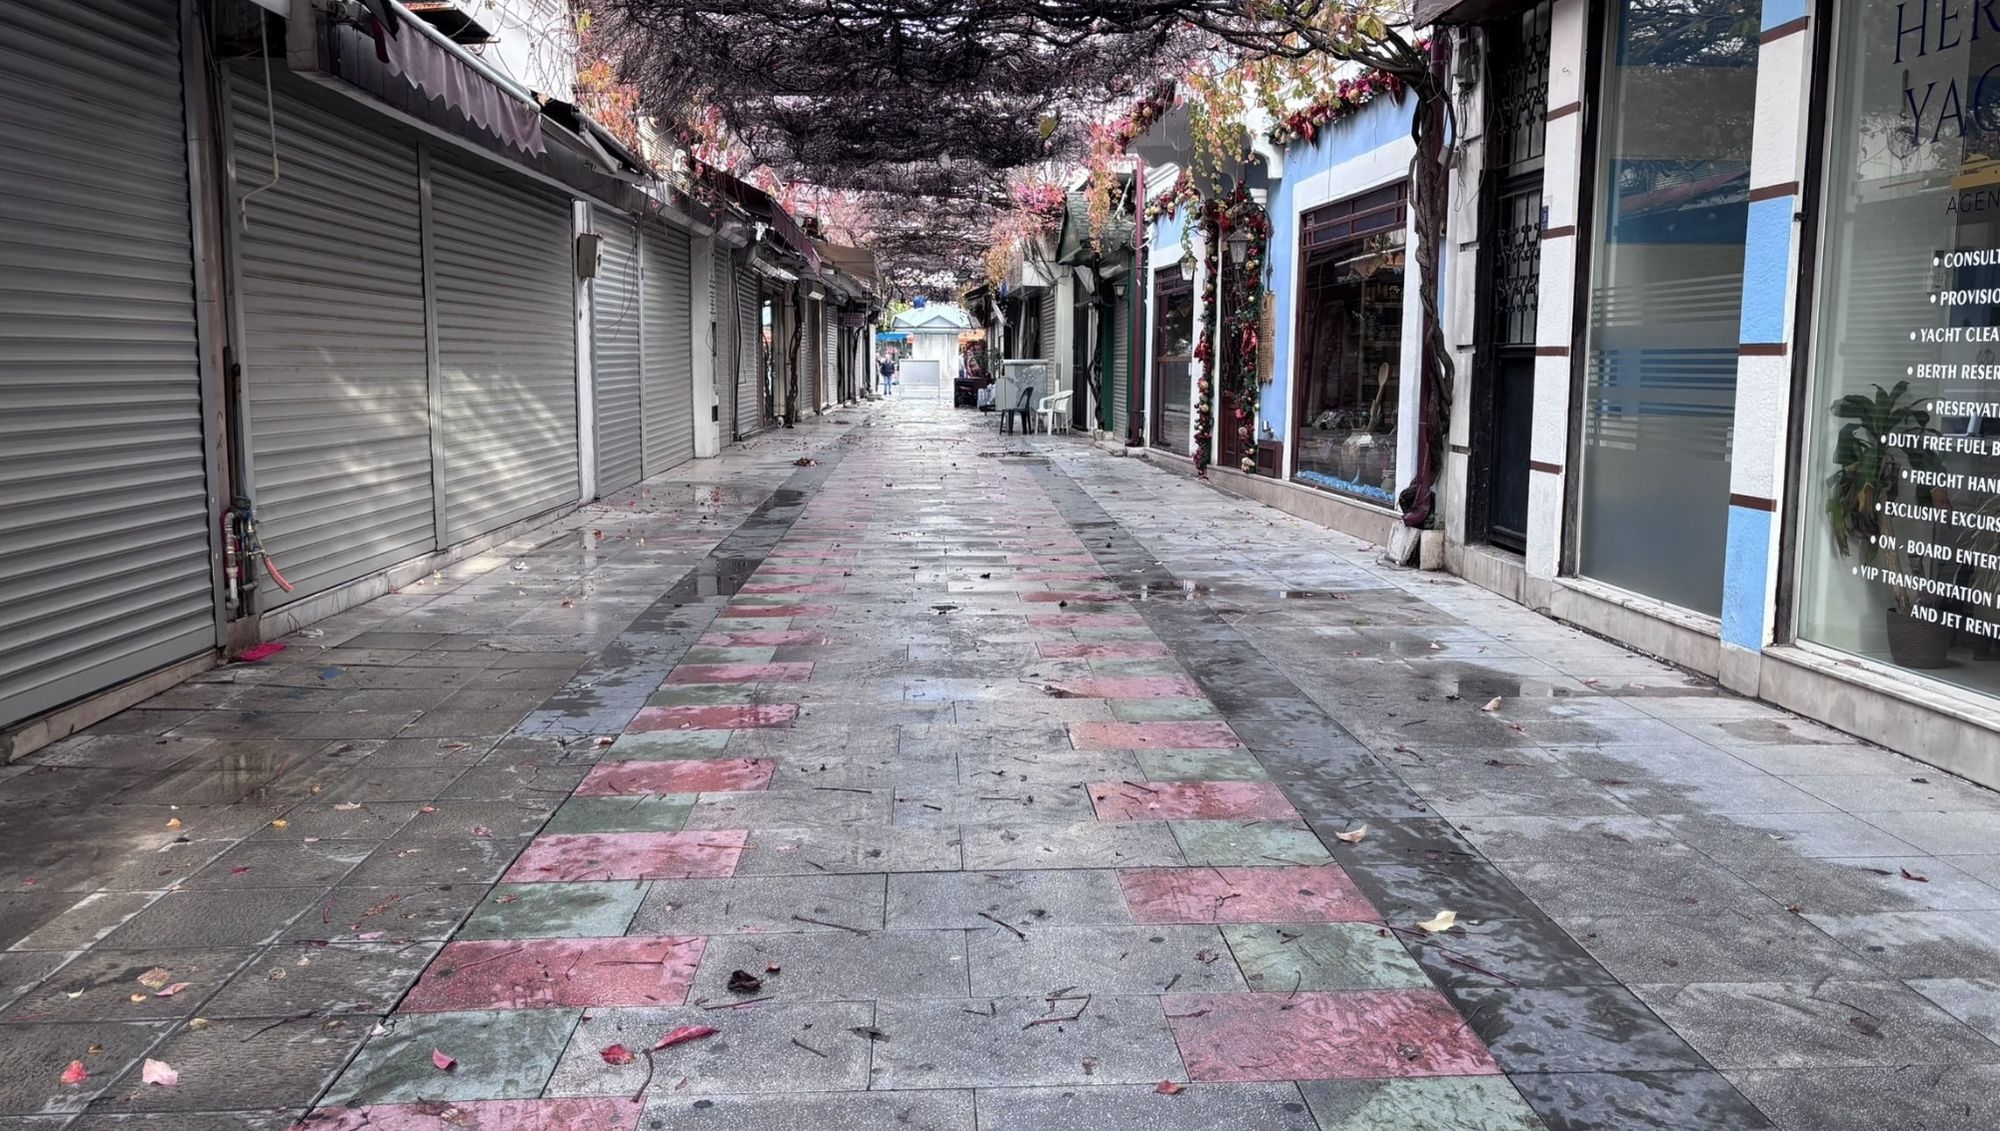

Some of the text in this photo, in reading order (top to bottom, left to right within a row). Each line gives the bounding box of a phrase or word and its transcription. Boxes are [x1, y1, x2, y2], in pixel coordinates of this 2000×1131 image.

[1920, 326, 2000, 343] YACHT CLEA
[1916, 364, 1957, 379] BERTH
[1888, 433, 1920, 449] DUTY
[1923, 435, 1953, 452] FREE
[1956, 438, 1988, 456] FUEL
[1910, 469, 1964, 489] FREIGHT
[1884, 500, 1948, 524] EXCLUSIVE
[1878, 534, 1896, 550] ON
[1907, 540, 1952, 561] BOARD
[1860, 564, 1878, 582] VIP
[1881, 568, 1992, 608] TRANSPORTATION
[1910, 604, 2000, 640] AND JET RENT
